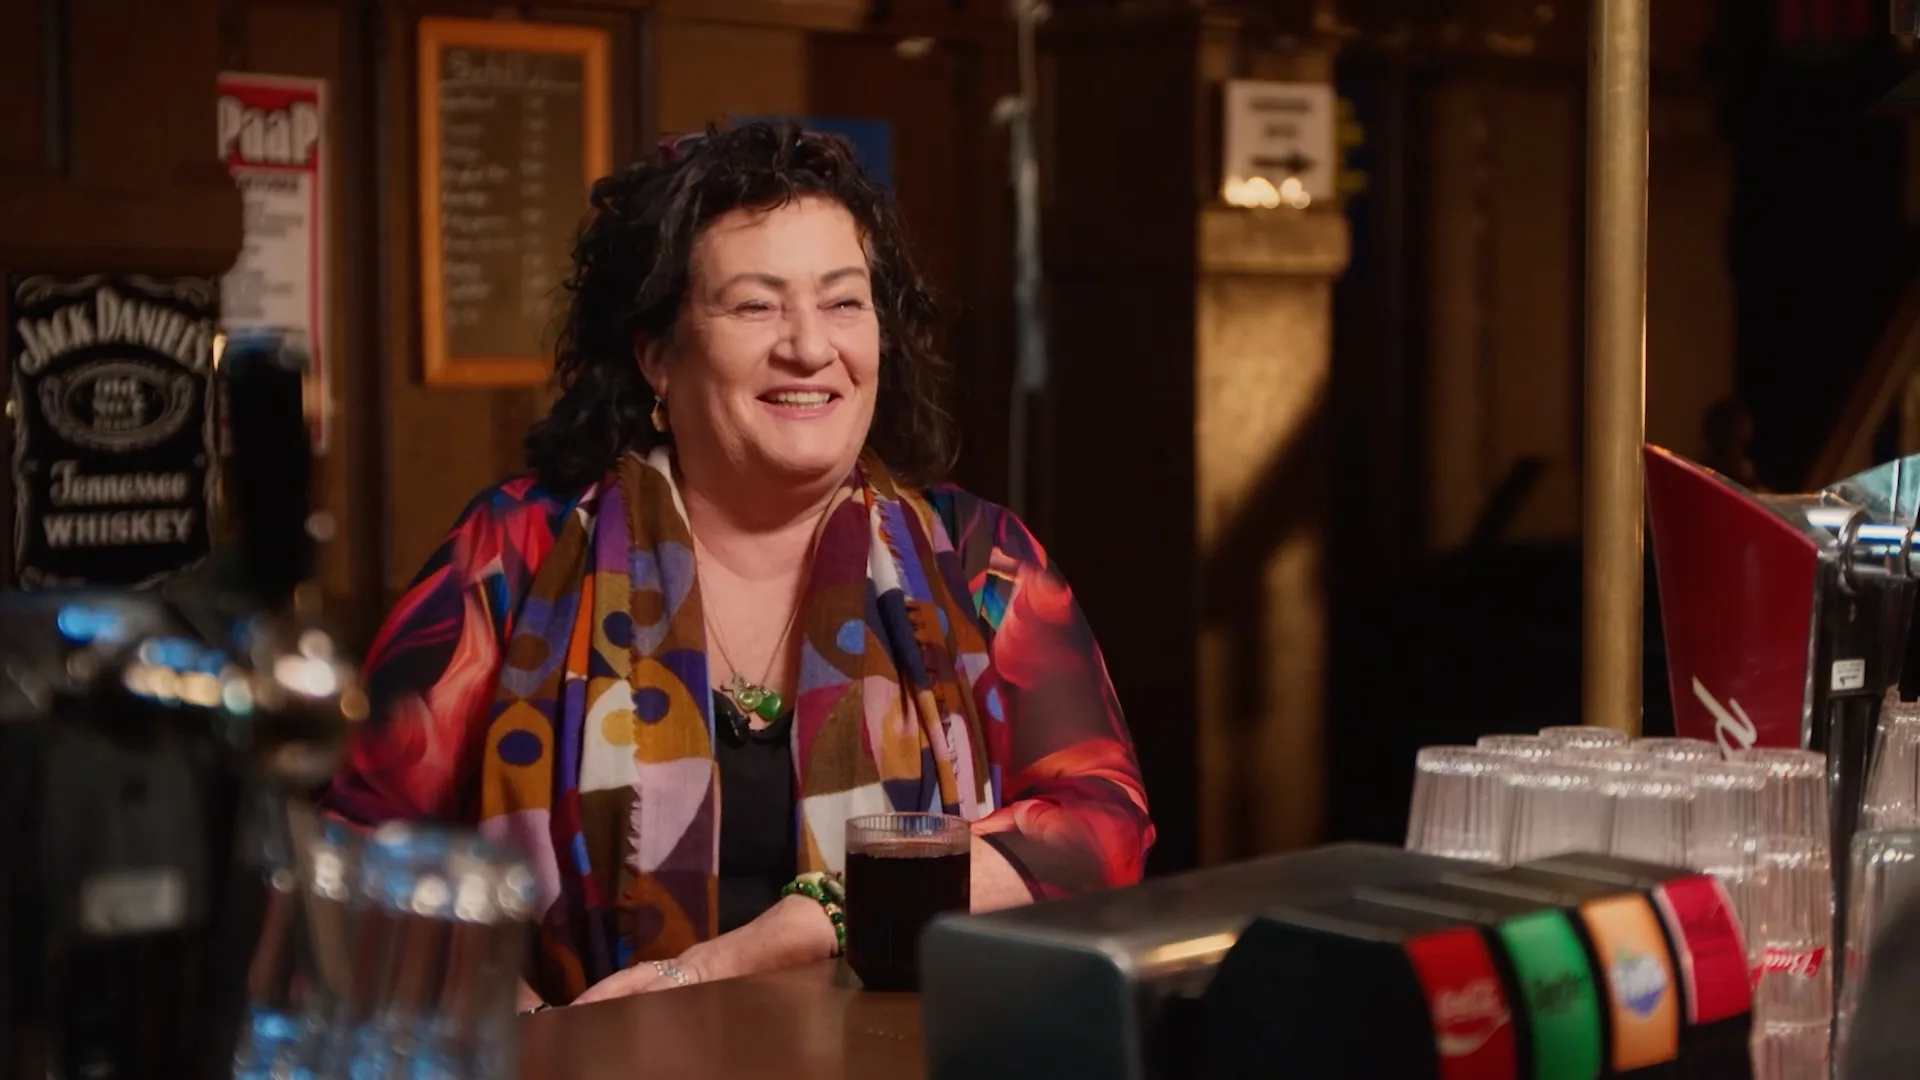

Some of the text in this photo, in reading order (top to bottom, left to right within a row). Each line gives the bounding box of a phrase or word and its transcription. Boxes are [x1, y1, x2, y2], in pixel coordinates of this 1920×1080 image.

[17, 302, 96, 376] JACK
[96, 286, 212, 371] DANIEL'S
[50, 459, 189, 506] Tennessee
[42, 507, 194, 548] WHISKEY
